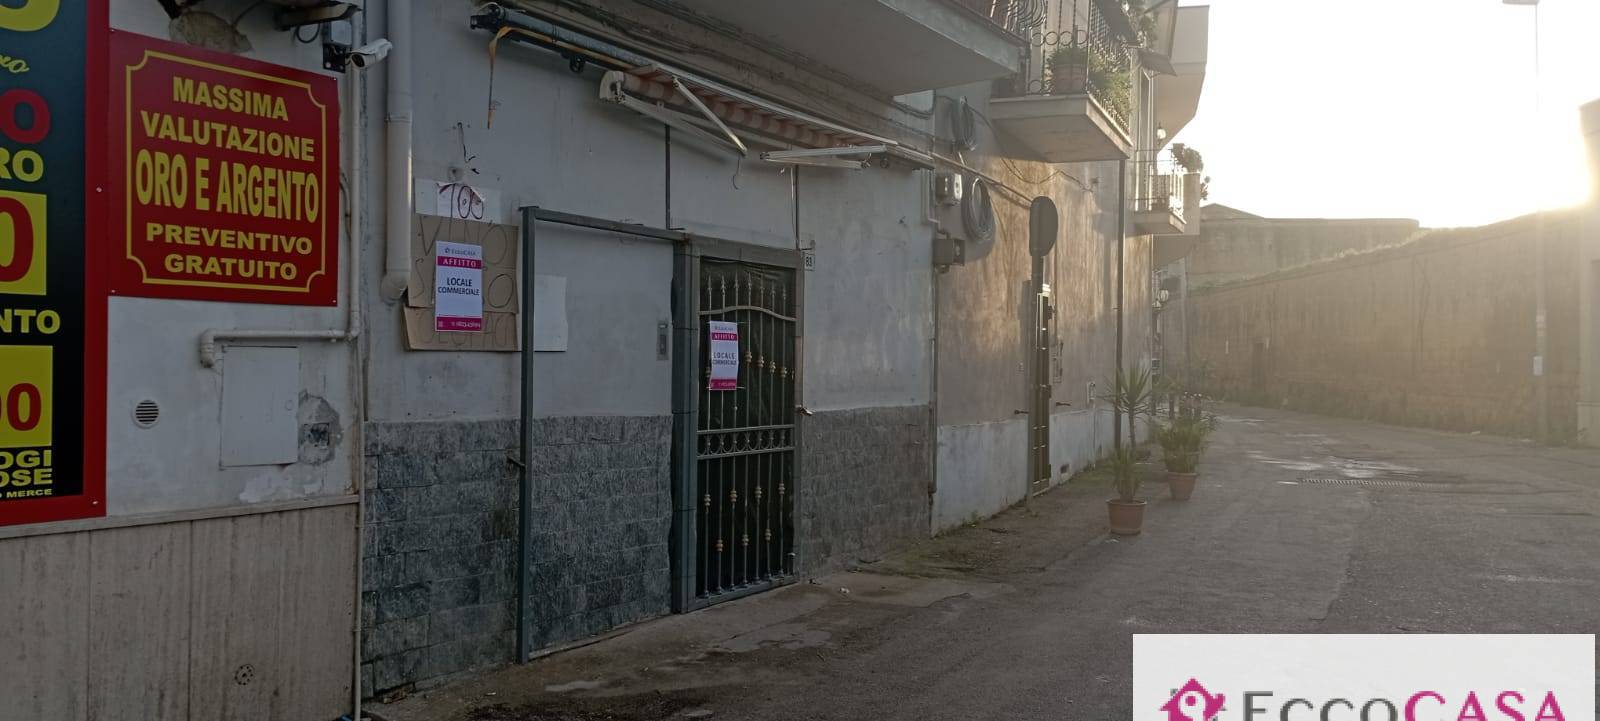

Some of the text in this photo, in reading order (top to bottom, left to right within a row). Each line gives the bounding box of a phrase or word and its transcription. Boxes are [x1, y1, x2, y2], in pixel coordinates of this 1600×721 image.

[172, 76, 289, 122] MASSIMA
[140, 110, 315, 163] VALUTAZIONE
[135, 149, 320, 223] ORO E ARGENTO
[146, 222, 313, 255] PREVENTIVO
[164, 253, 298, 281] GRATUITO
[443, 258, 477, 268] AFFITTO
[438, 286, 480, 296] COMMERCIALE
[446, 277, 473, 287] LOCALE
[0, 382, 42, 432] 0
[6, 488, 53, 499] MERCE
